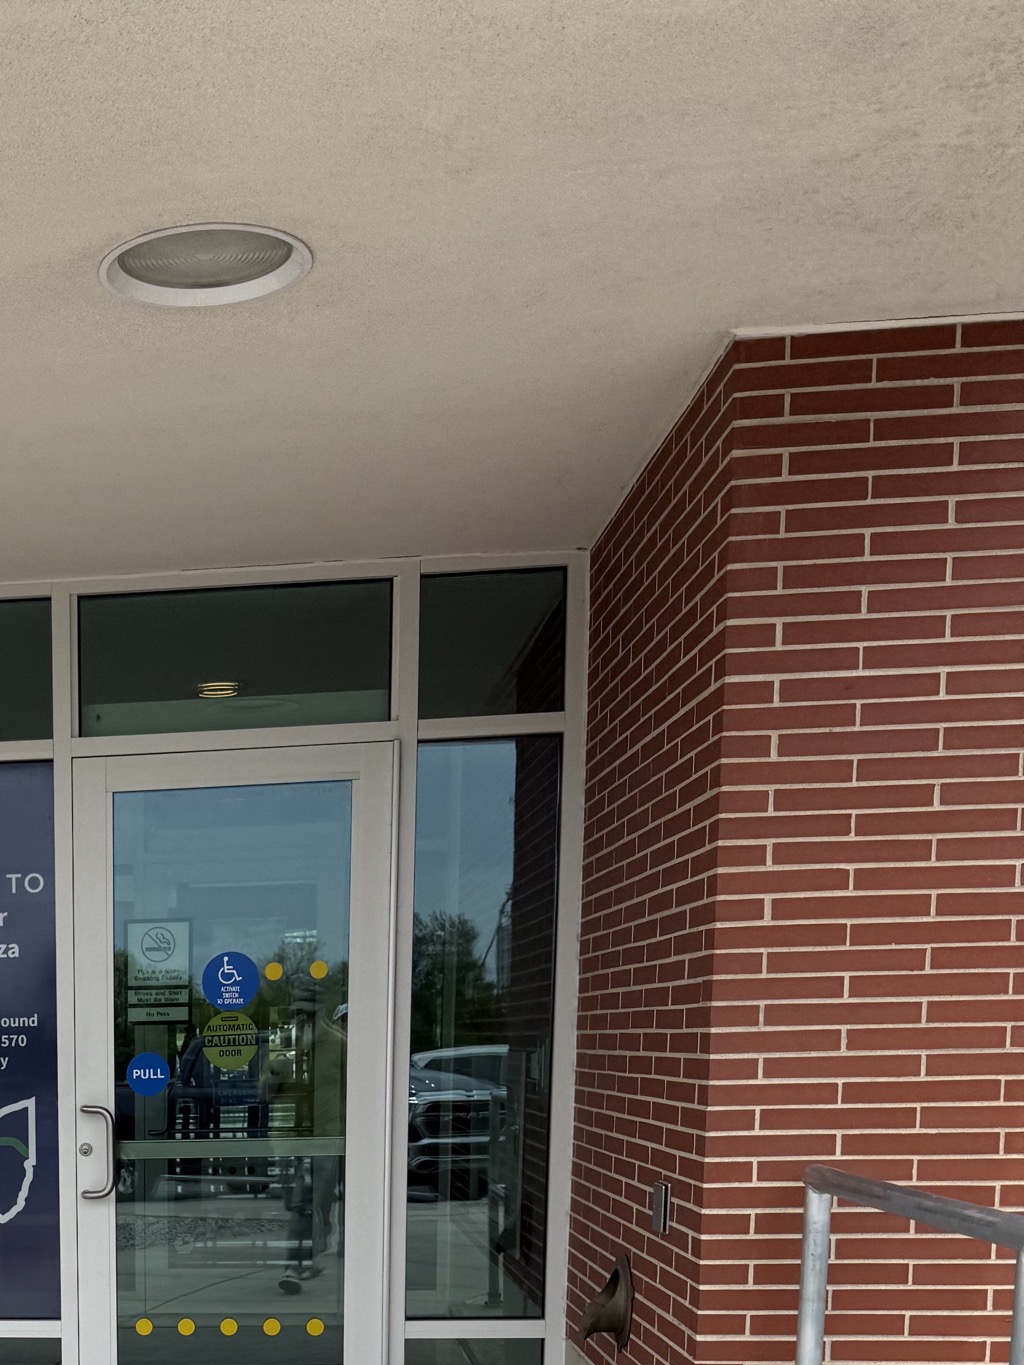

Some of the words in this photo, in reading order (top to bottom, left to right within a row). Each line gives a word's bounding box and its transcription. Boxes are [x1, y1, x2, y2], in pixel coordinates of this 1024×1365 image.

[5, 873, 45, 895] TO
[206, 1023, 254, 1032] AUTOMATIC
[205, 1034, 256, 1046] CAUTION
[219, 1049, 242, 1057] DOOR
[133, 1068, 165, 1080] PULL
